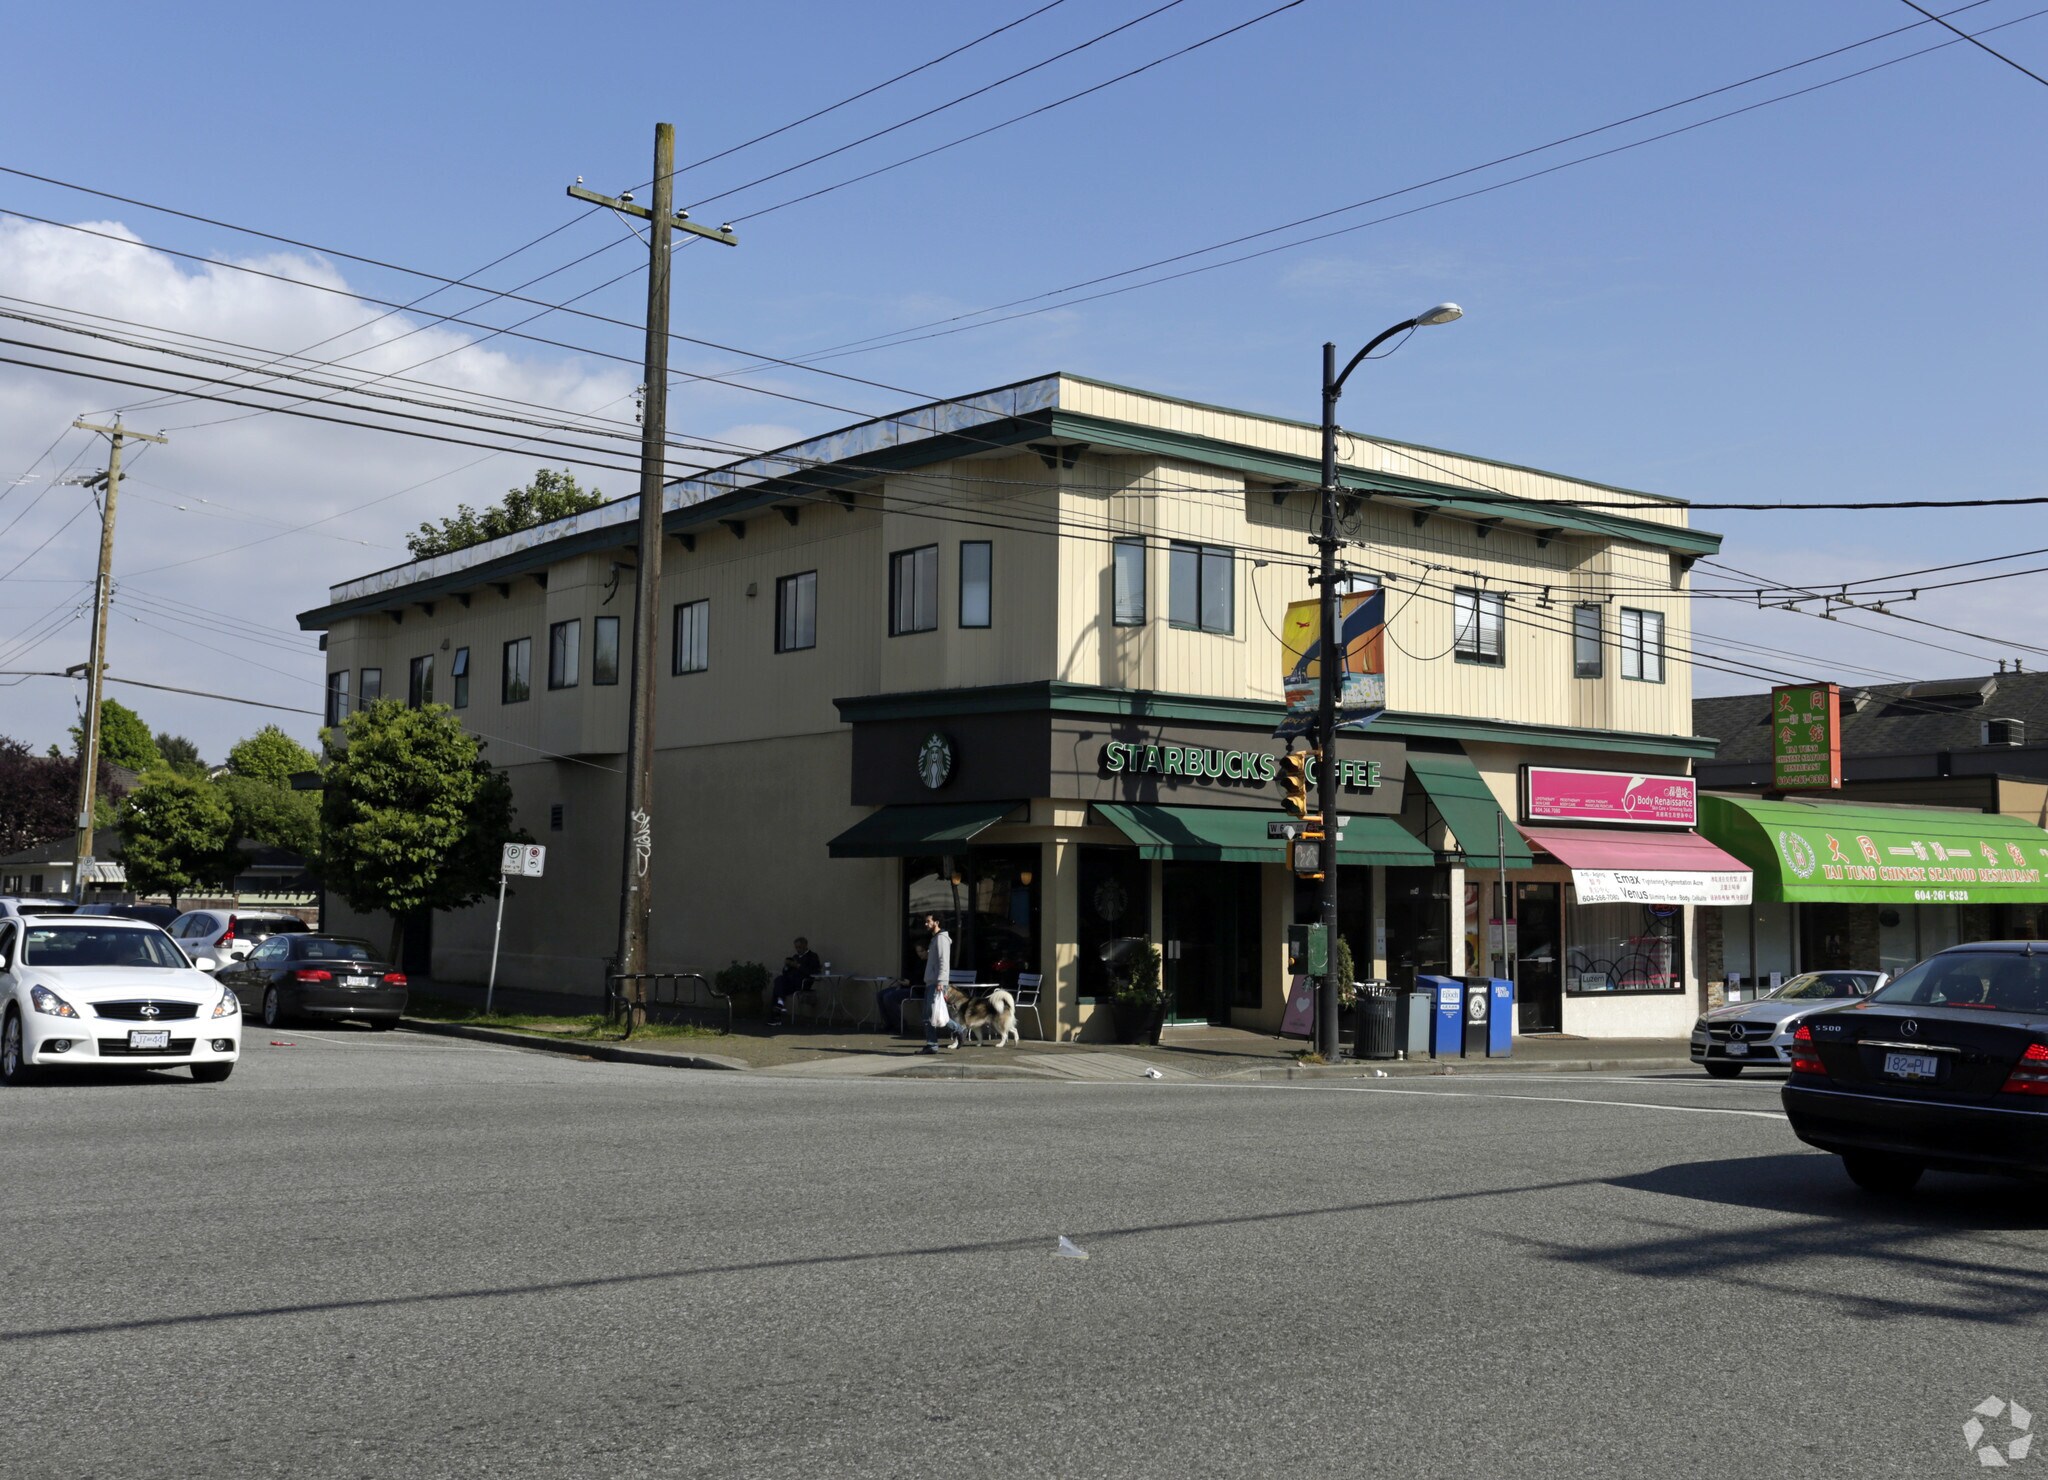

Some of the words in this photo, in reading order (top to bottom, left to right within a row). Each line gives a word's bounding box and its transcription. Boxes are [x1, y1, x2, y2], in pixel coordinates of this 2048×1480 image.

[1785, 745, 1798, 753] TAI
[1799, 744, 1818, 753] TUNG
[1106, 741, 1276, 781] STARBUCKS
[1637, 795, 1653, 807] Body
[1655, 796, 1693, 807] Renaissance
[1270, 824, 1277, 832] W
[1614, 873, 1641, 884] Emax
[1642, 878, 1665, 886] Tightening
[1822, 864, 1843, 880] TAI
[1845, 865, 1877, 881] TUNG
[1879, 866, 1927, 882] CHINESE
[1928, 867, 1977, 882] SEAFOOD
[1978, 867, 2040, 883] RESTAURANT
[1582, 894, 1620, 902] 604-266-7080
[1620, 887, 1649, 900] Venus
[1914, 889, 1969, 901] 604-261-6328
[1442, 990, 1458, 1000] Epoch
[1887, 1056, 1907, 1071] 182
[1913, 1058, 1936, 1075] PLL
